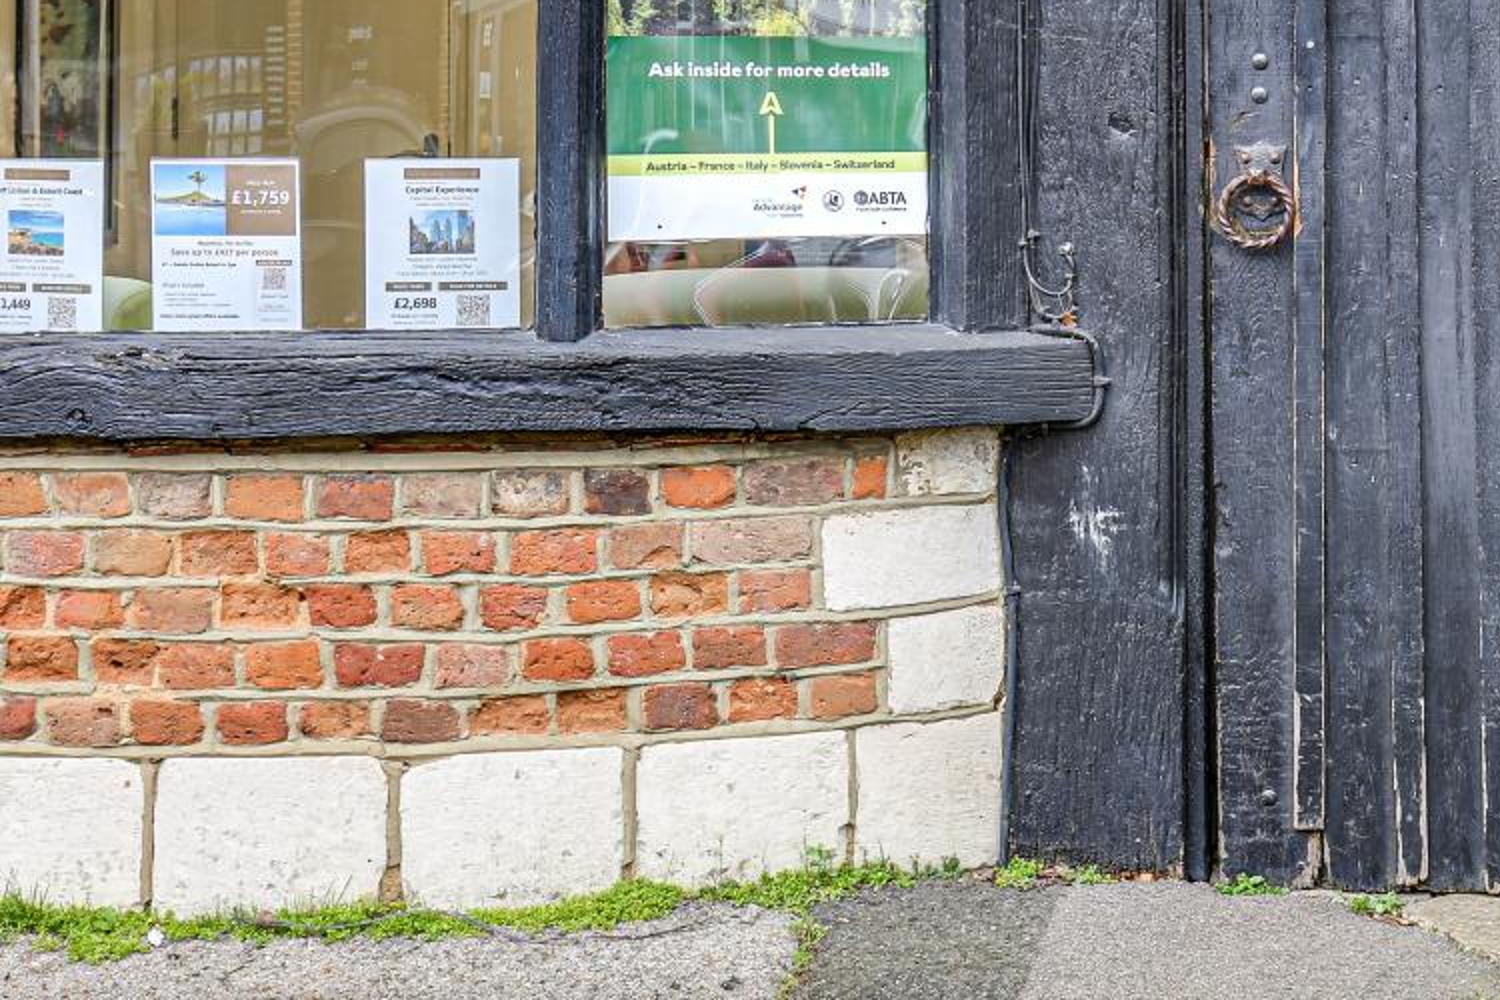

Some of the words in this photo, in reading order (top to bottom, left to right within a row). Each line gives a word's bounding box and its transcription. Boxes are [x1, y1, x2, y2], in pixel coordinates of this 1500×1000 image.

[648, 62, 684, 78] Ask
[687, 62, 743, 78] inside
[745, 62, 772, 78] for
[777, 65, 825, 78] more
[827, 61, 890, 78] details
[646, 161, 687, 172] Austria
[698, 161, 735, 172] France
[745, 160, 769, 173] Italy
[780, 160, 824, 171] Slovenia
[833, 159, 895, 170] Switzerland
[405, 186, 434, 195] Capital
[435, 186, 480, 195] Experience
[231, 189, 290, 207] £1,759
[867, 191, 907, 205] ABTA
[393, 296, 437, 311] £2,698
